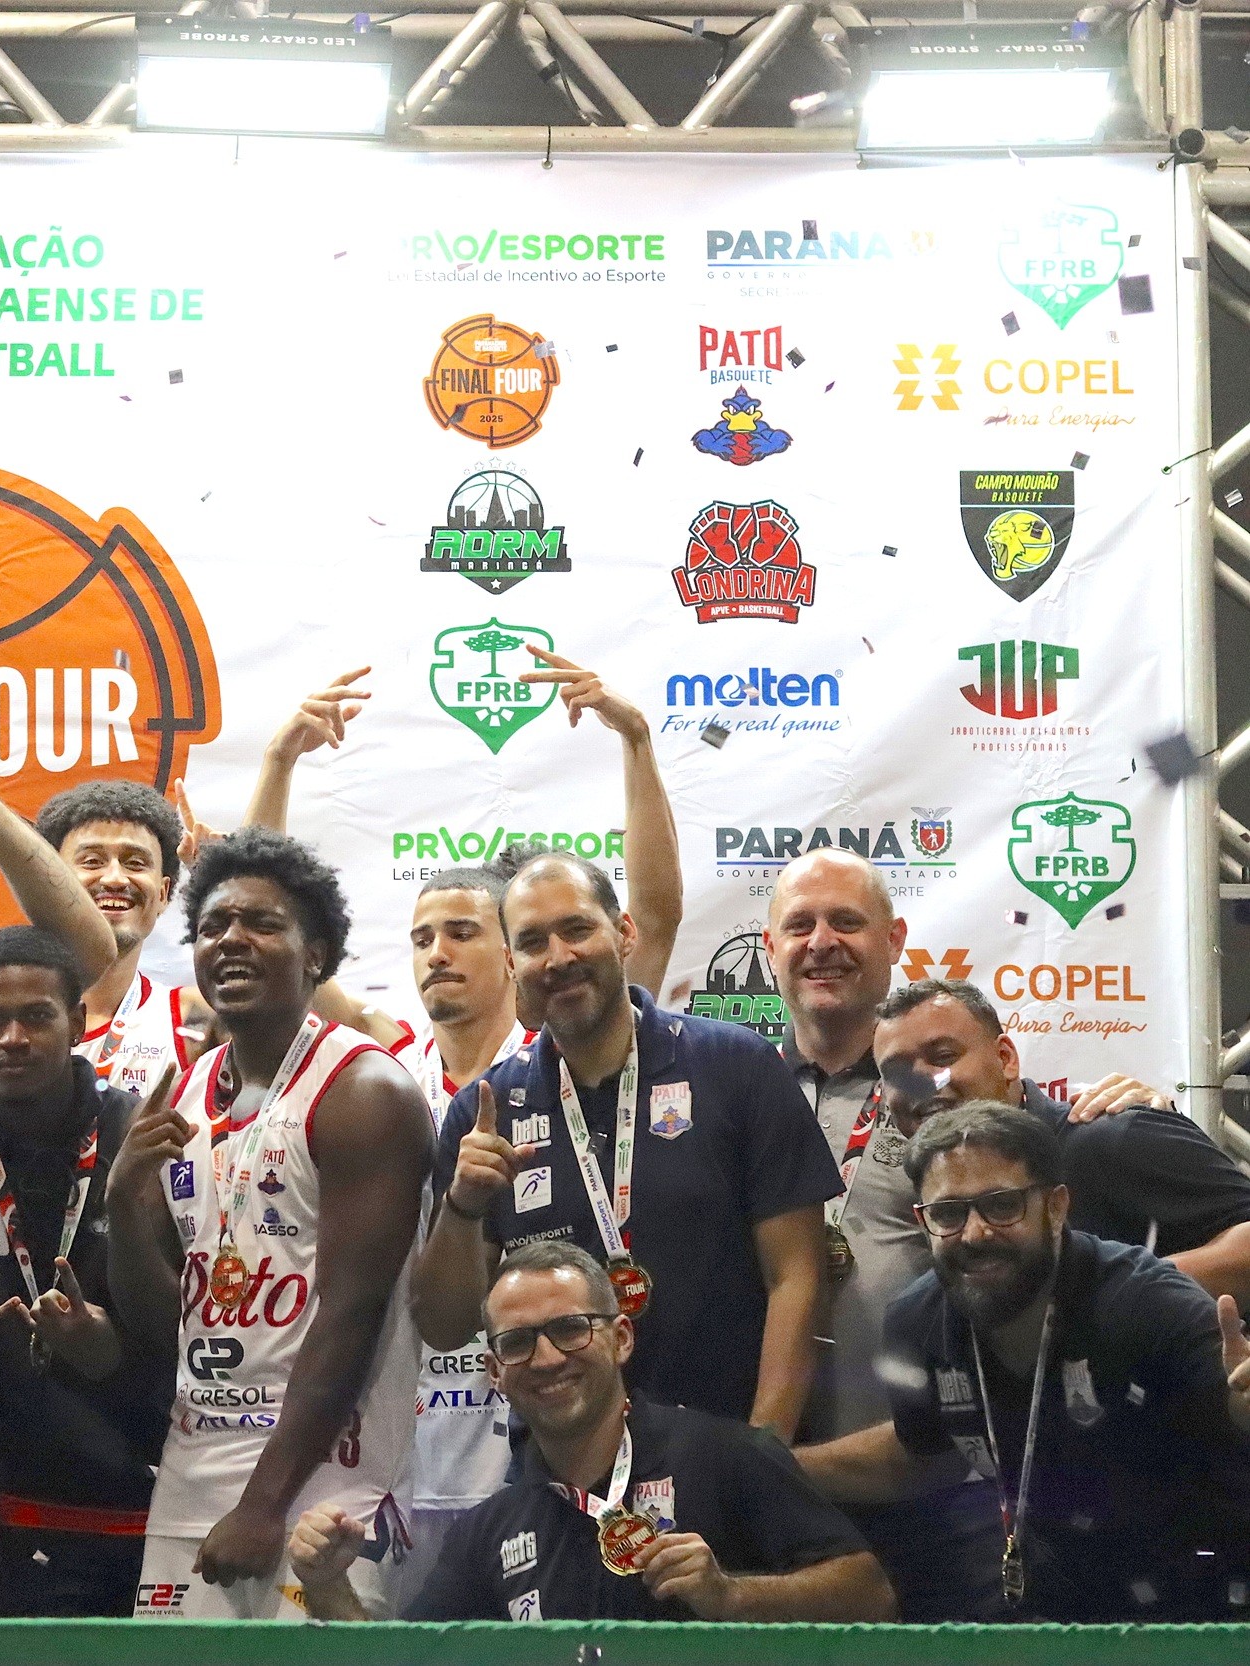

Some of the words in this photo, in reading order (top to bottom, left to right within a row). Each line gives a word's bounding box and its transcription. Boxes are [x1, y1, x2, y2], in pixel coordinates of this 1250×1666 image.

[180, 32, 250, 43] STROBE
[260, 34, 318, 46] CRAZY
[323, 37, 356, 46] LED
[910, 44, 979, 54] STROBE
[995, 44, 1047, 53] CRAZ
[1052, 44, 1085, 53] LED
[414, 269, 479, 283] Estadual
[483, 270, 503, 282] de
[507, 269, 578, 282] Incentivo
[582, 272, 602, 282] ao
[606, 269, 666, 284] Esporte
[1024, 258, 1097, 278] FPRB
[150, 287, 205, 321] DE
[699, 324, 783, 373] PATO
[440, 368, 493, 395] FINAL
[494, 367, 543, 395] FOUR
[710, 369, 773, 385] BASQUETE
[983, 359, 1135, 395] COPEL
[479, 413, 504, 423] 2025
[1048, 405, 1136, 433] Energia
[975, 474, 1013, 490] CAMPO
[1013, 472, 1059, 490] MOURÃO
[991, 491, 1043, 502] BASQUETE
[430, 528, 563, 560] ADRM
[450, 558, 544, 571] MARINGÁ
[672, 564, 818, 605] LONDRINA
[710, 605, 730, 616] APVE
[738, 604, 785, 616] BASKETBALL
[666, 667, 840, 707] molten
[958, 638, 1080, 720] JUP
[457, 681, 533, 702] FPRB
[660, 713, 695, 733] For
[735, 713, 780, 731] real
[782, 719, 841, 739] game
[950, 726, 1017, 736] JABOTICABAL
[1022, 726, 1091, 736] UNIFORMES
[973, 742, 1068, 752] PROFISSIONAIS
[716, 822, 906, 858] PARANÁ
[392, 868, 416, 881] Lei
[889, 869, 958, 878] STADO
[1035, 856, 1110, 877] FPRB
[889, 886, 925, 897] ORTE
[993, 964, 1146, 1001] COPEL
[691, 994, 790, 1023] ADR
[1059, 1011, 1148, 1041] Energia
[122, 1067, 146, 1083] PATO
[655, 1082, 688, 1103] PATO
[511, 1112, 551, 1147] bets
[263, 1149, 285, 1165] PATO
[625, 1282, 645, 1296] FOUR
[428, 1353, 487, 1375] CRES
[190, 1385, 276, 1407] CRESOL
[428, 1387, 505, 1408] ATLA
[196, 1413, 276, 1430] ATLAS
[637, 1481, 670, 1502] PATO
[500, 1530, 538, 1570] bets
